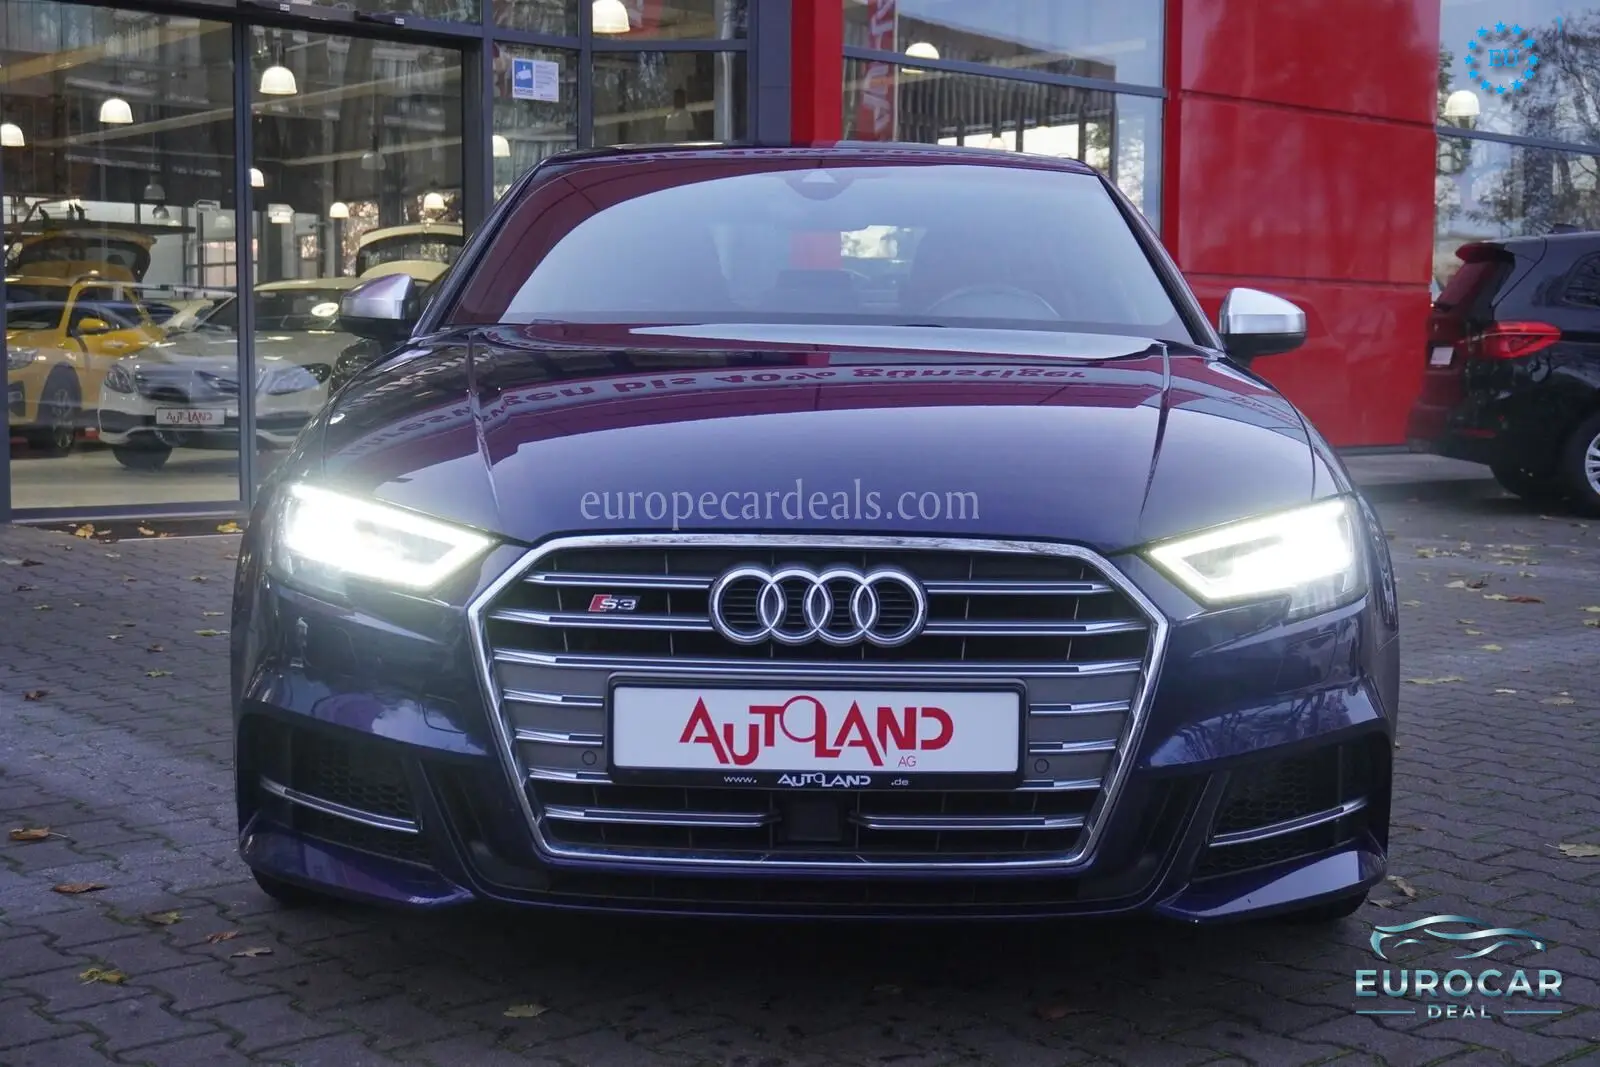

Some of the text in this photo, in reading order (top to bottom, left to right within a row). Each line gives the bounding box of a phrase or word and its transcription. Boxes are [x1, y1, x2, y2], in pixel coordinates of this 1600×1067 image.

[600, 598, 637, 611] S3
[679, 695, 954, 767] AUTOLAND
[898, 755, 916, 768] AG
[723, 772, 909, 788] www. AUTOLAND .de
